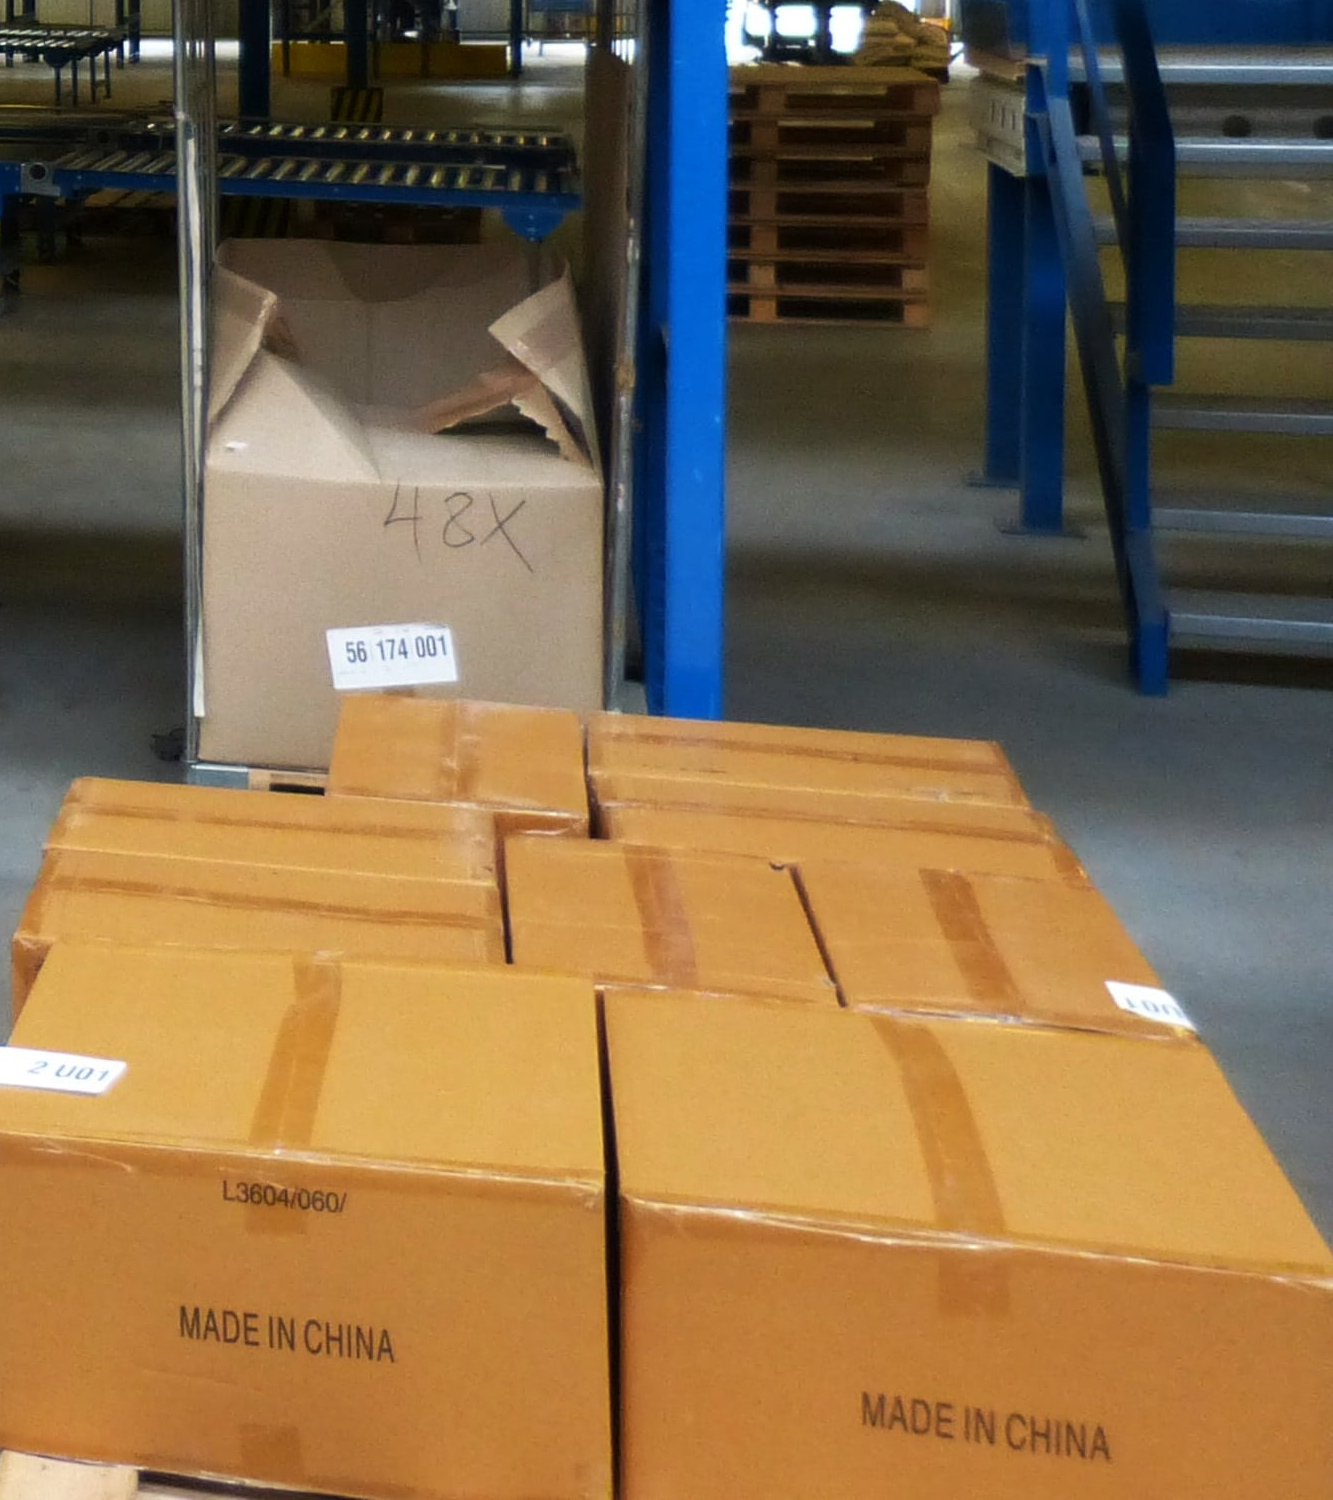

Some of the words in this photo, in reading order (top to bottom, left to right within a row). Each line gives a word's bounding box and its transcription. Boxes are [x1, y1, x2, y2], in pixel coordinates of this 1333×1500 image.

[345, 640, 368, 663] 56
[376, 638, 408, 660] 174
[415, 634, 447, 658] 001
[27, 1060, 48, 1075] 2
[55, 1064, 110, 1082] U01
[180, 1305, 260, 1347] MADE
[269, 1316, 296, 1351] IN
[304, 1319, 395, 1363] CHINA
[861, 1391, 955, 1440] MADE
[964, 1407, 996, 1445] IN
[1005, 1413, 1112, 1461] CHINA
